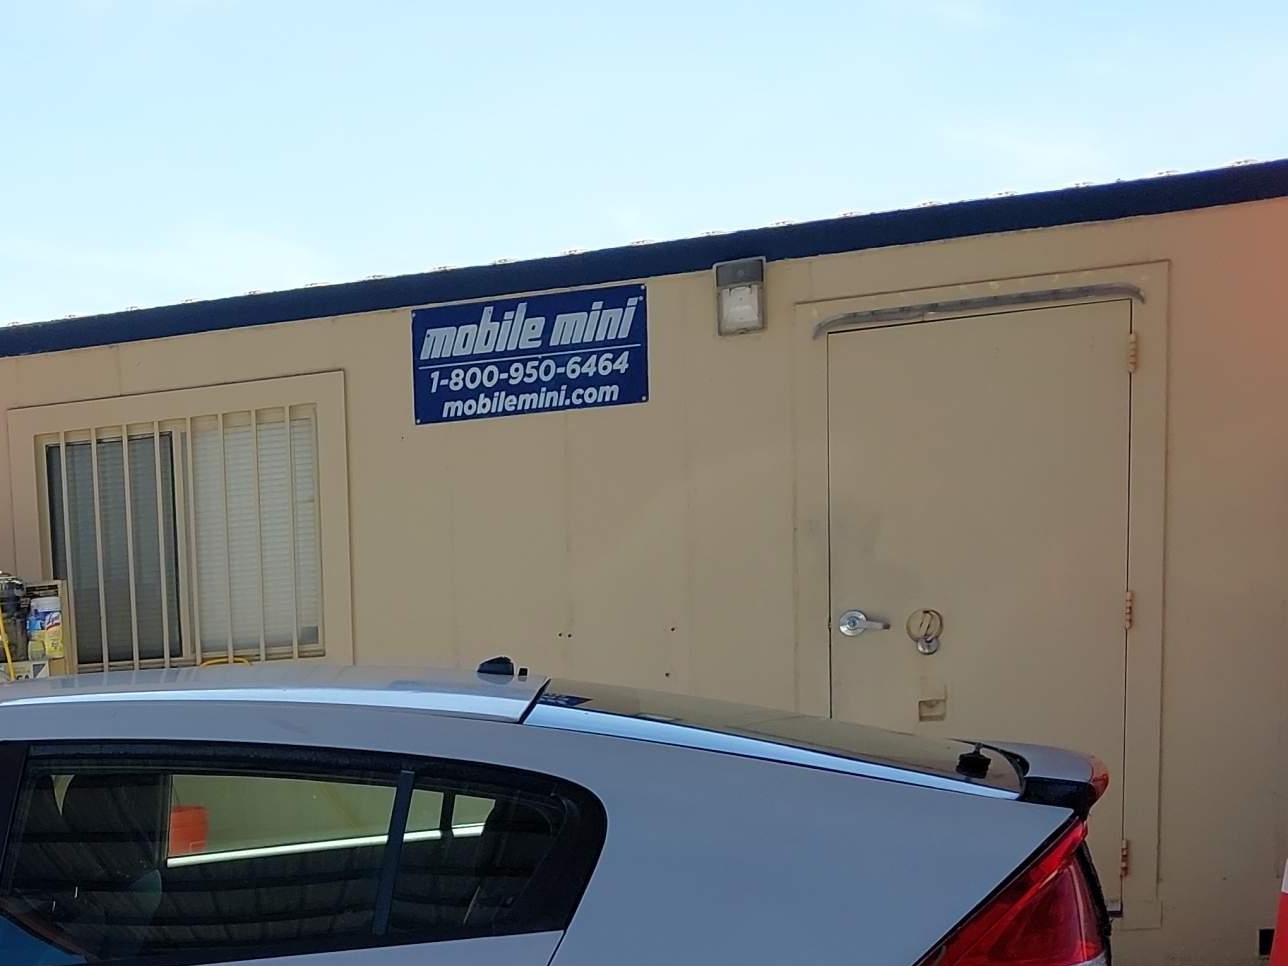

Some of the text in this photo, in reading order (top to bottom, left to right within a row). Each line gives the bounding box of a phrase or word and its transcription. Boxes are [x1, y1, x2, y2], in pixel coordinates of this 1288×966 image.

[420, 297, 639, 360] mobile mini
[429, 350, 630, 393] 1-800-950-6464
[442, 384, 619, 418] mobilemini.com
